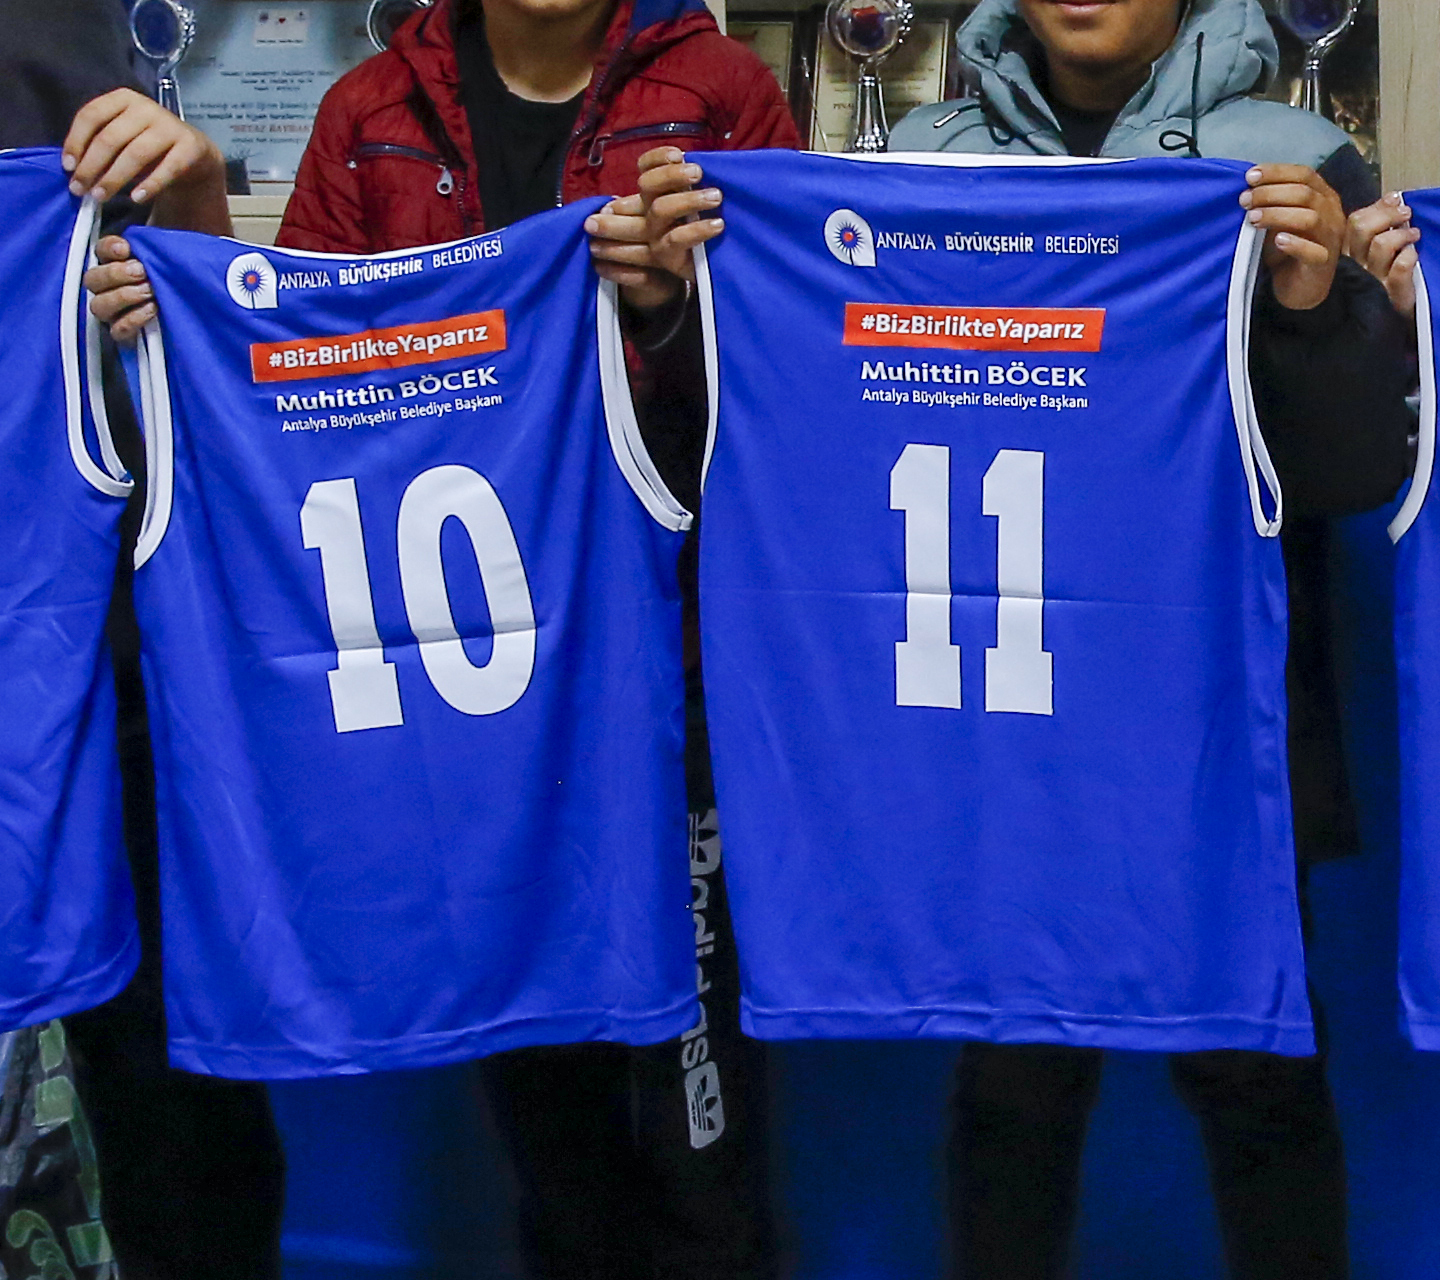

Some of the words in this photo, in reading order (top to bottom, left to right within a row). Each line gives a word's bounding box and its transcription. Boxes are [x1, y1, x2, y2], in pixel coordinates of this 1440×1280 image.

[279, 271, 332, 291] ANTALYA
[338, 257, 423, 286] BÜYÜKŞEHİR
[432, 235, 503, 270] BELEDİYESİ
[876, 231, 936, 251] ANTALYA
[945, 232, 1034, 256] BÜYÜKŞEHİR
[1045, 232, 1119, 255] BELEDİYESİ
[268, 324, 488, 368] #BizBirlikteYaparız
[860, 313, 1085, 344] #BizBirlikteYaparız
[276, 383, 395, 413] Muhittin
[399, 366, 499, 399] BÖCEK
[860, 360, 979, 385] Muhittin
[987, 361, 1087, 387] BÖCEK
[282, 415, 328, 433] Antalya
[330, 409, 397, 429] Büyükşehir
[399, 401, 452, 420] Belediye
[454, 393, 502, 412] Başkanı
[862, 387, 909, 405] Antalya
[912, 389, 981, 408] Büyükşehir
[983, 393, 1037, 410] Belediye
[1040, 394, 1088, 411] Başkanı
[299, 464, 537, 734] 10
[888, 445, 1055, 715] 11
